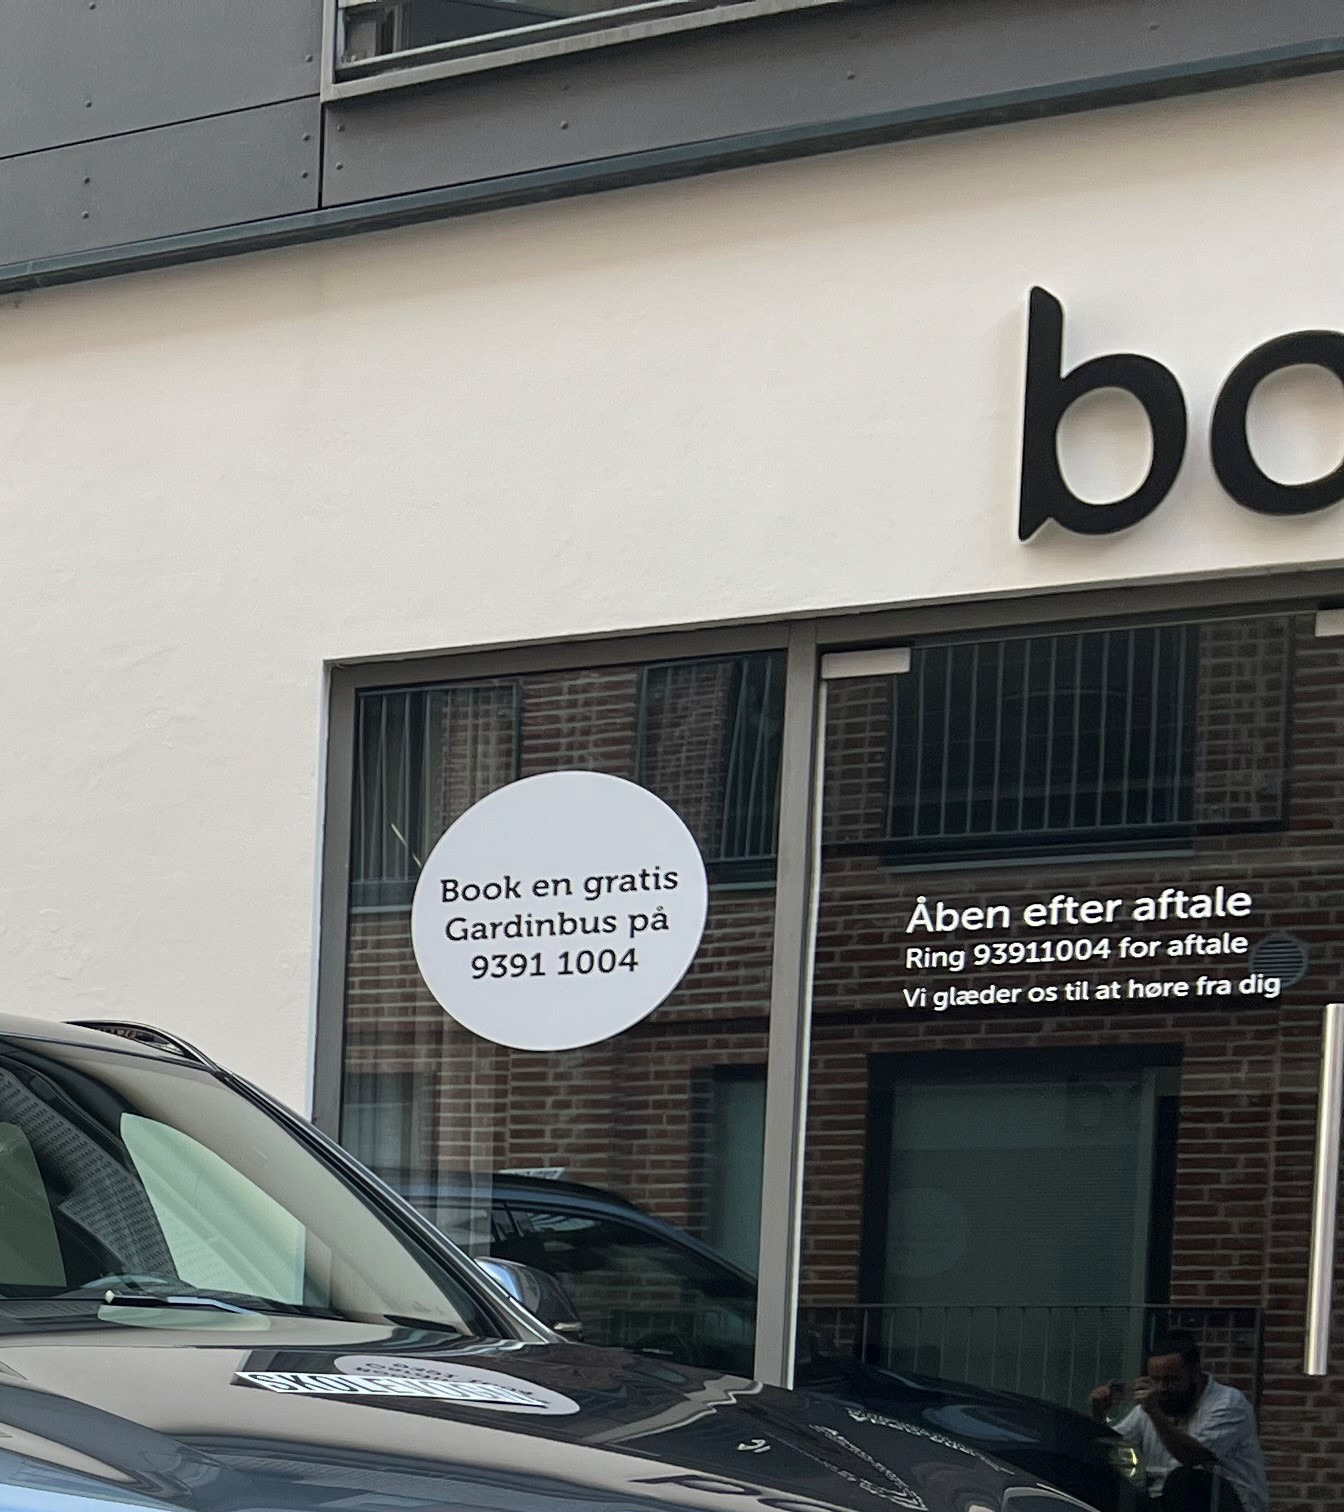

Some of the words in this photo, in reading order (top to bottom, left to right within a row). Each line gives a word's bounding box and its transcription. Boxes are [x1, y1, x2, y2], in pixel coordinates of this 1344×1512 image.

[440, 876, 522, 903] Book
[532, 877, 572, 897] en
[584, 866, 679, 901] gratis
[445, 912, 617, 941] Gardinbus
[629, 905, 670, 938] på
[906, 896, 1010, 933] Åben
[1023, 895, 1122, 927] efter
[1133, 886, 1252, 922] aftale
[471, 952, 546, 979] 9391
[558, 948, 639, 975] 1004
[905, 947, 966, 972] Ring
[973, 939, 1111, 967] 93911004
[1119, 936, 1162, 959] for
[1167, 932, 1249, 957] aftale
[903, 987, 926, 1008] Vi
[933, 984, 1022, 1012] glæder
[1028, 986, 1058, 1002] os
[1064, 981, 1089, 1001] til
[1095, 980, 1122, 1001] at
[1128, 978, 1189, 999] høre
[1196, 976, 1232, 996] fra
[1238, 973, 1282, 999] dig
